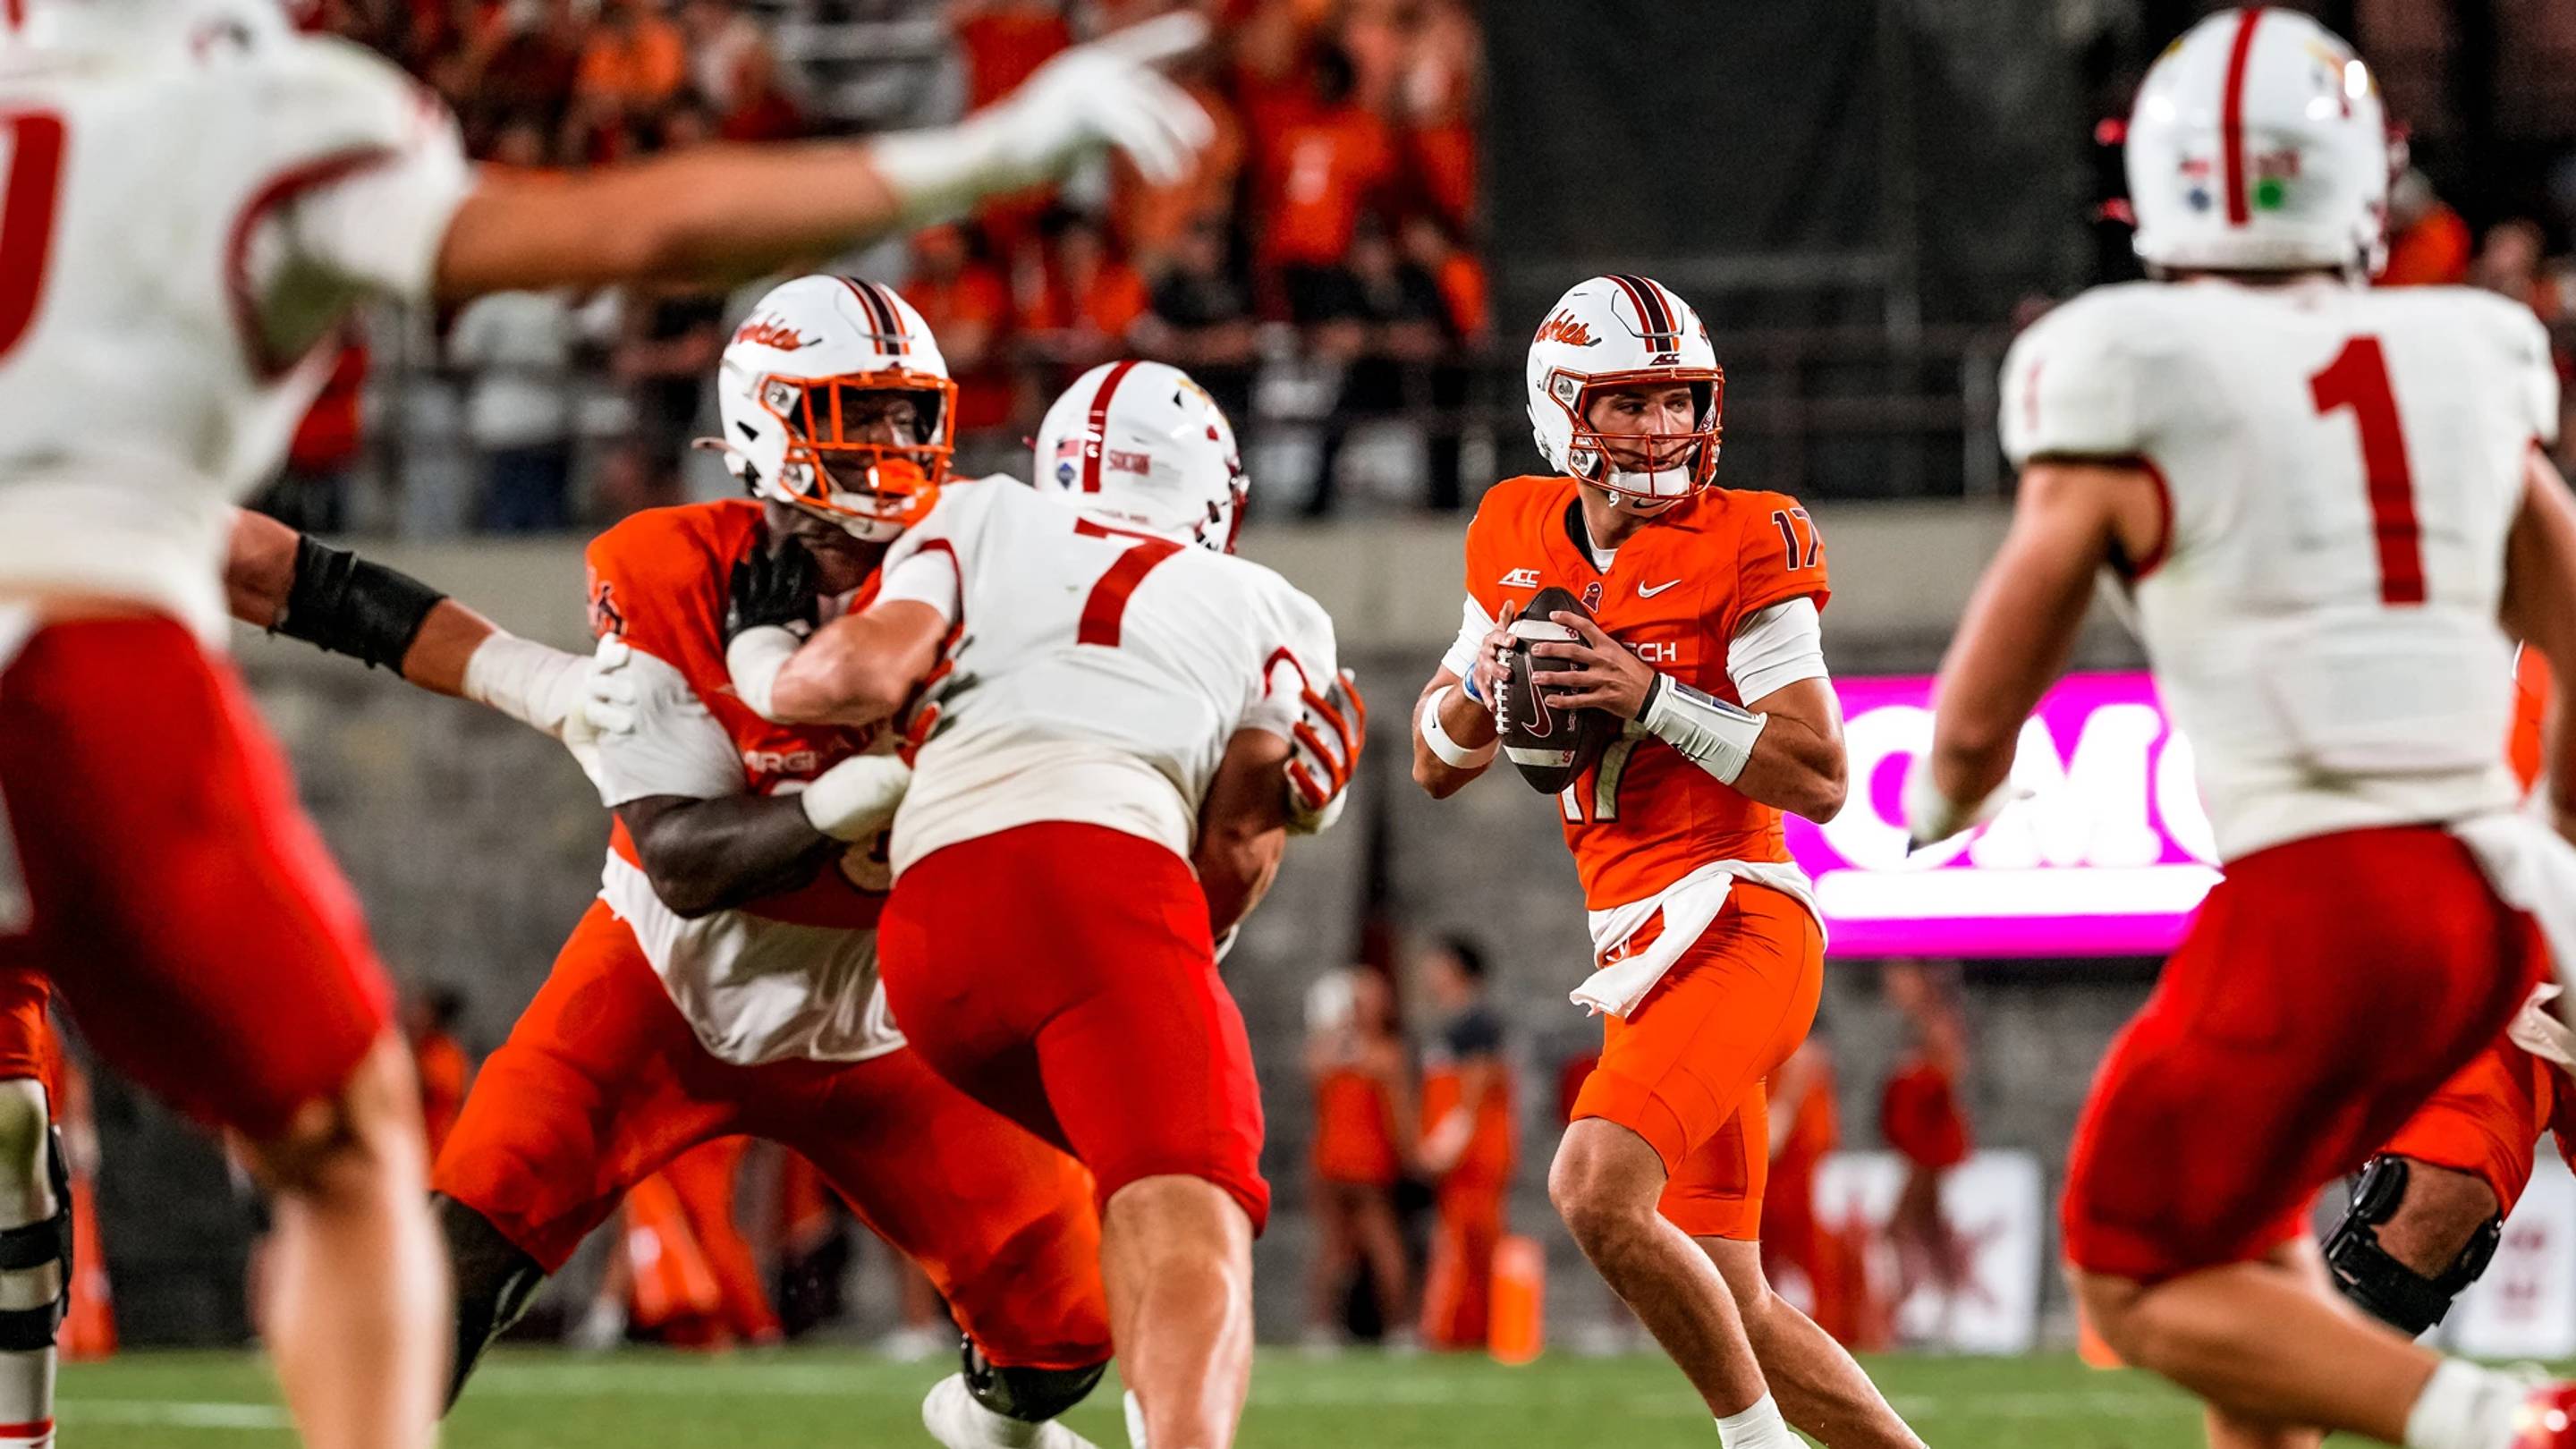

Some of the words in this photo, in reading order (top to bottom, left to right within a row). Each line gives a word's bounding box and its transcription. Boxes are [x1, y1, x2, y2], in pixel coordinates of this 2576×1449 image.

[1648, 353, 1681, 366] ACC
[2305, 334, 2428, 605] 1
[1771, 507, 1820, 572] 17
[1073, 516, 1187, 648] 7
[1497, 567, 1541, 589] ACC
[1622, 641, 1677, 662] CH
